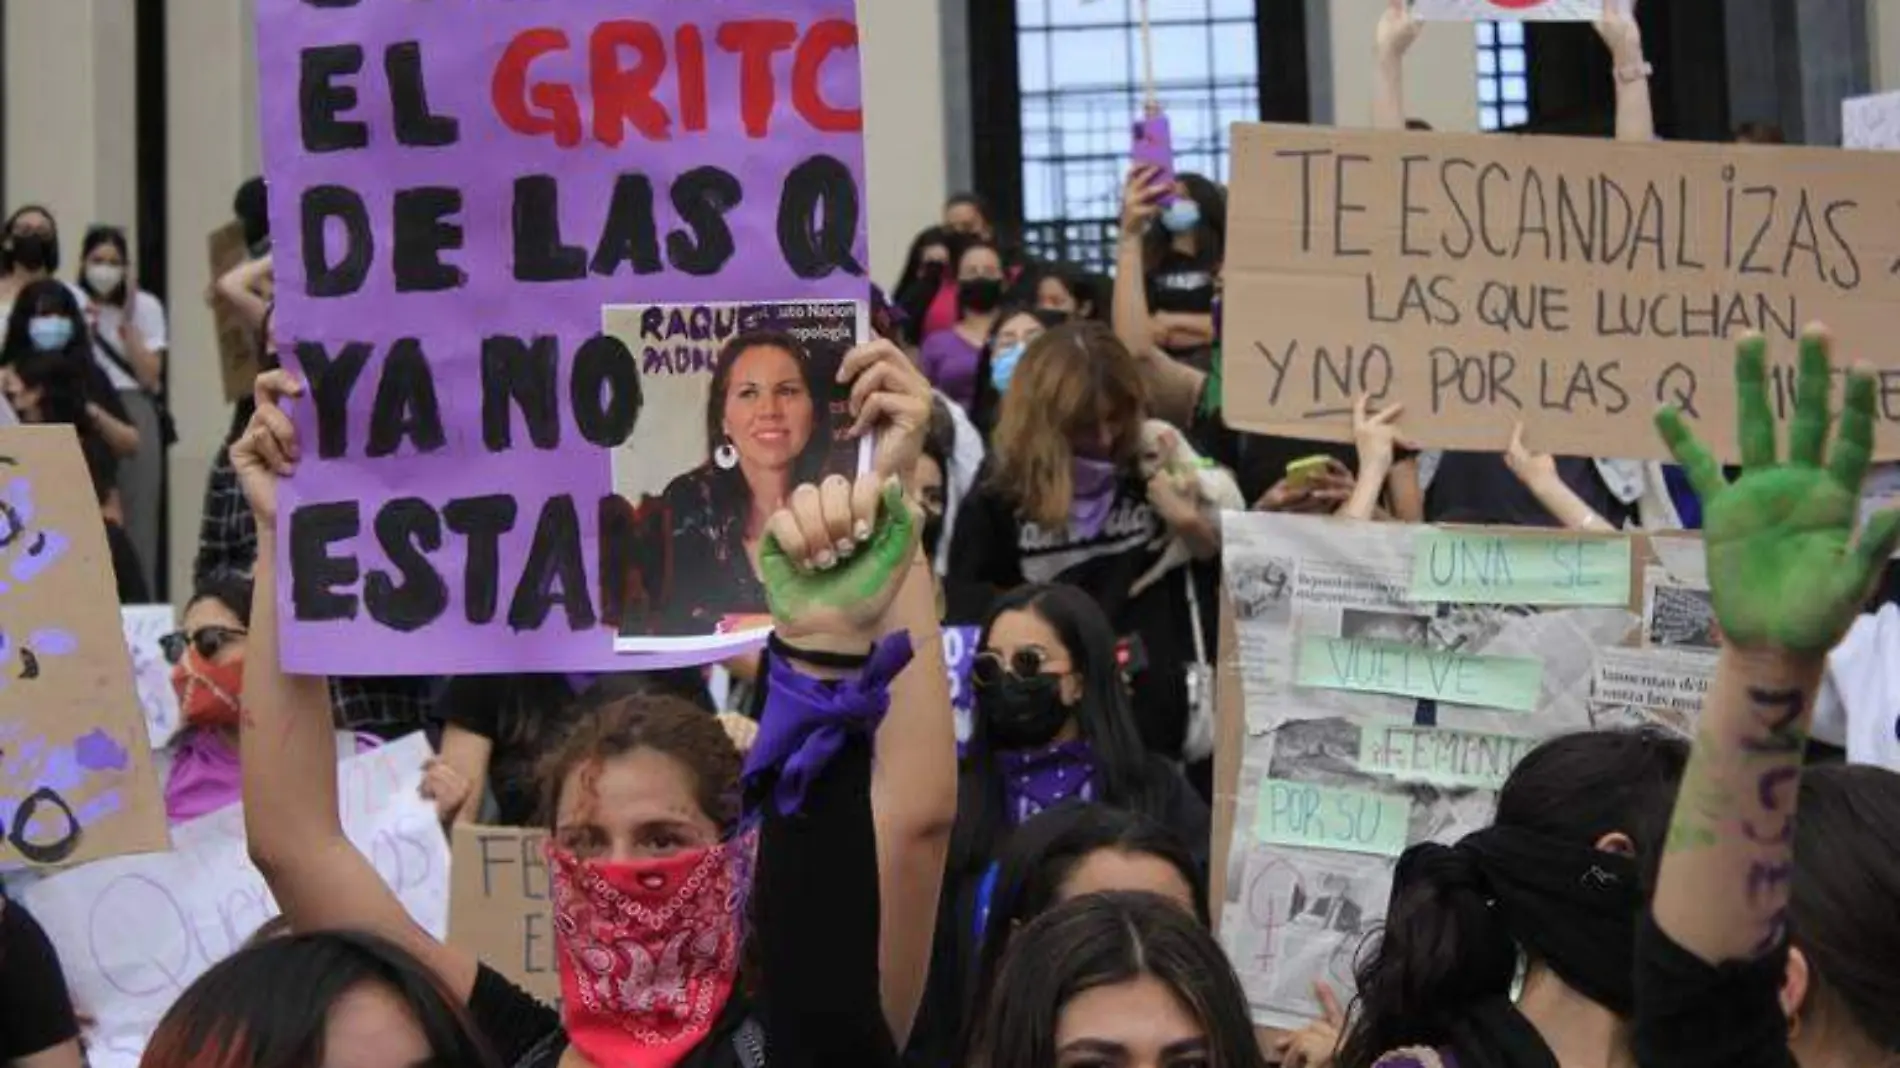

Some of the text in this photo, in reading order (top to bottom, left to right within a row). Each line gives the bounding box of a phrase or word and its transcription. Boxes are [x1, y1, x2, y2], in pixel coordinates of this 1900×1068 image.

[300, 40, 460, 153] EL
[301, 154, 866, 298] DE LAS Q
[1275, 150, 1372, 256] TE
[1365, 272, 1796, 340] LAS QUE LUCHAN
[293, 334, 645, 460] YA NO
[1254, 338, 1298, 407] Y
[1312, 343, 1394, 402] NO
[1428, 346, 1523, 414] POR
[1541, 359, 1630, 414] LAS
[1656, 362, 1700, 419] Q
[289, 494, 674, 633] ESTAN
[1429, 536, 1515, 587] UNA
[1548, 536, 1609, 589] SE
[1328, 640, 1482, 696] VUELVE
[1270, 784, 1384, 844] POR SU
[477, 835, 555, 900] FE
[525, 912, 560, 974] E
